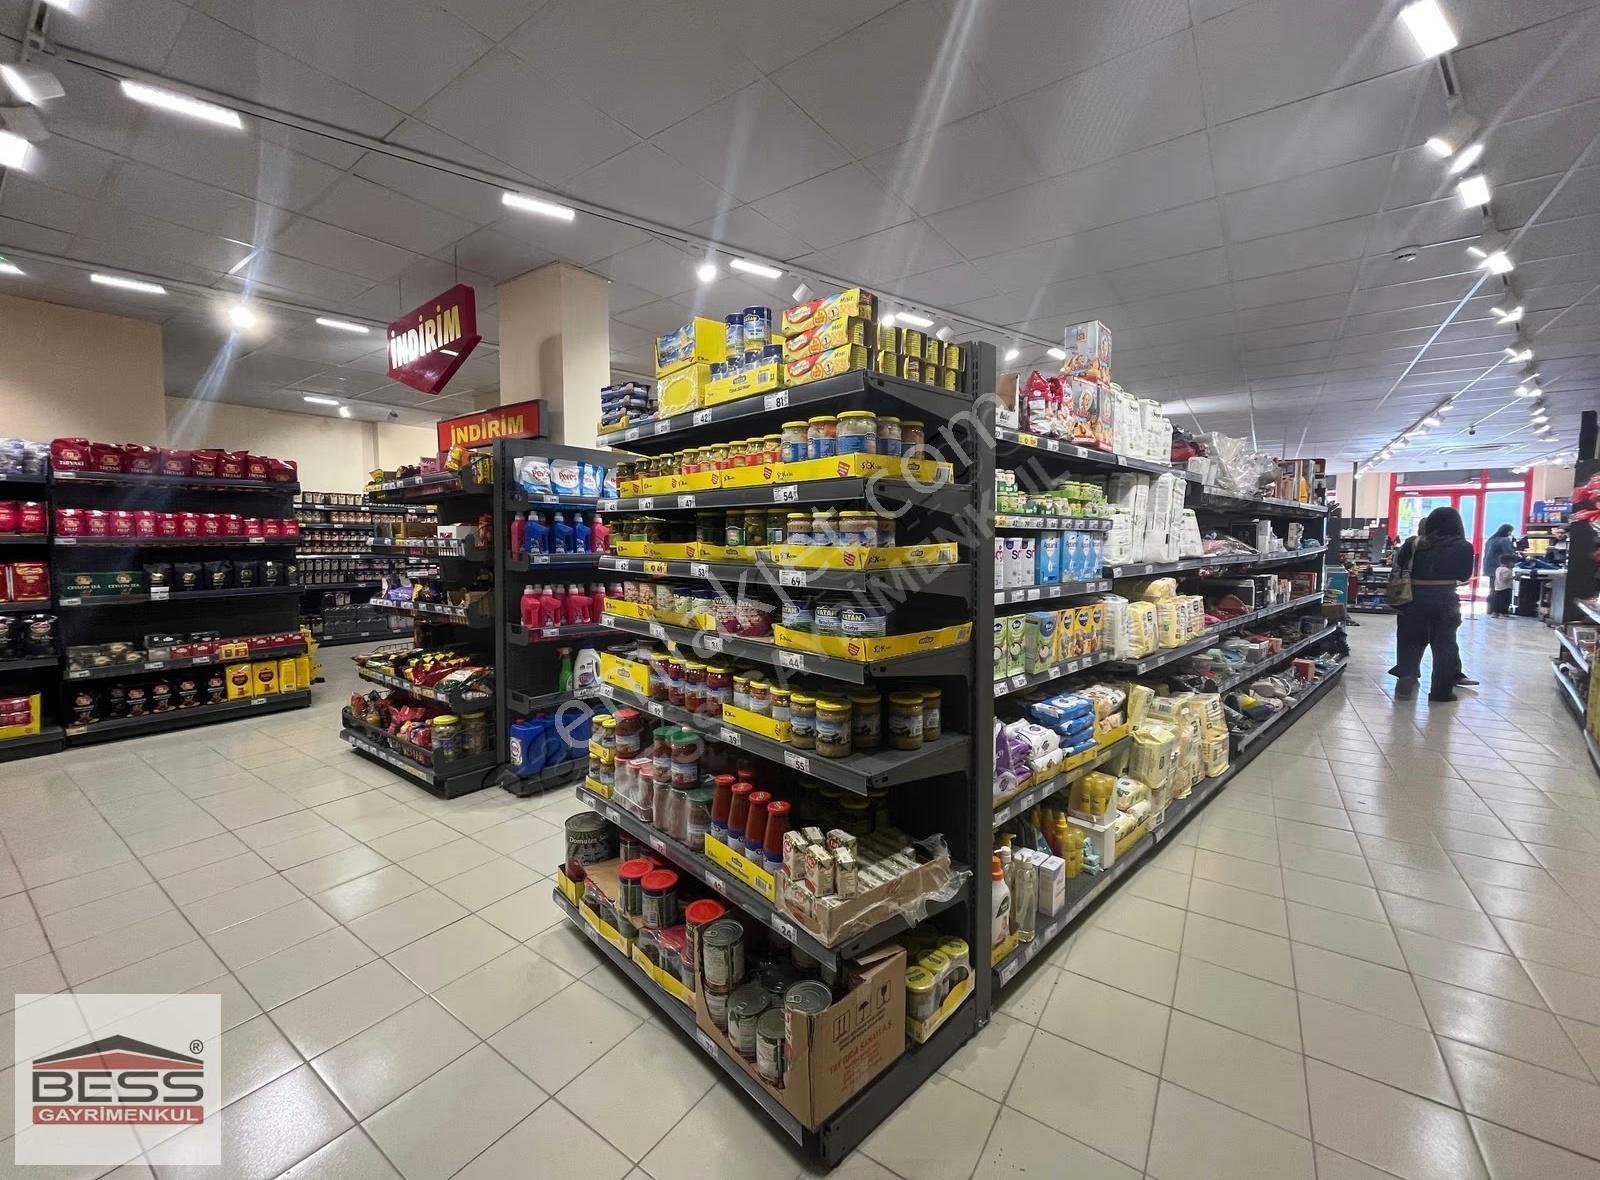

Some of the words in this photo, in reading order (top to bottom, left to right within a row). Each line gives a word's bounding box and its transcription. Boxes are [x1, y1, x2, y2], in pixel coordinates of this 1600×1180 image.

[390, 305, 461, 369] İNDİRİM
[776, 397, 784, 407] 81
[700, 414, 708, 422] 42
[450, 415, 524, 446] İNDİRİM
[783, 491, 794, 501] 54
[698, 568, 705, 576] 53
[791, 576, 801, 586] 69
[788, 658, 799, 668] 44
[728, 735, 737, 745] 39
[795, 761, 804, 770] 55
[781, 924, 793, 938] 24
